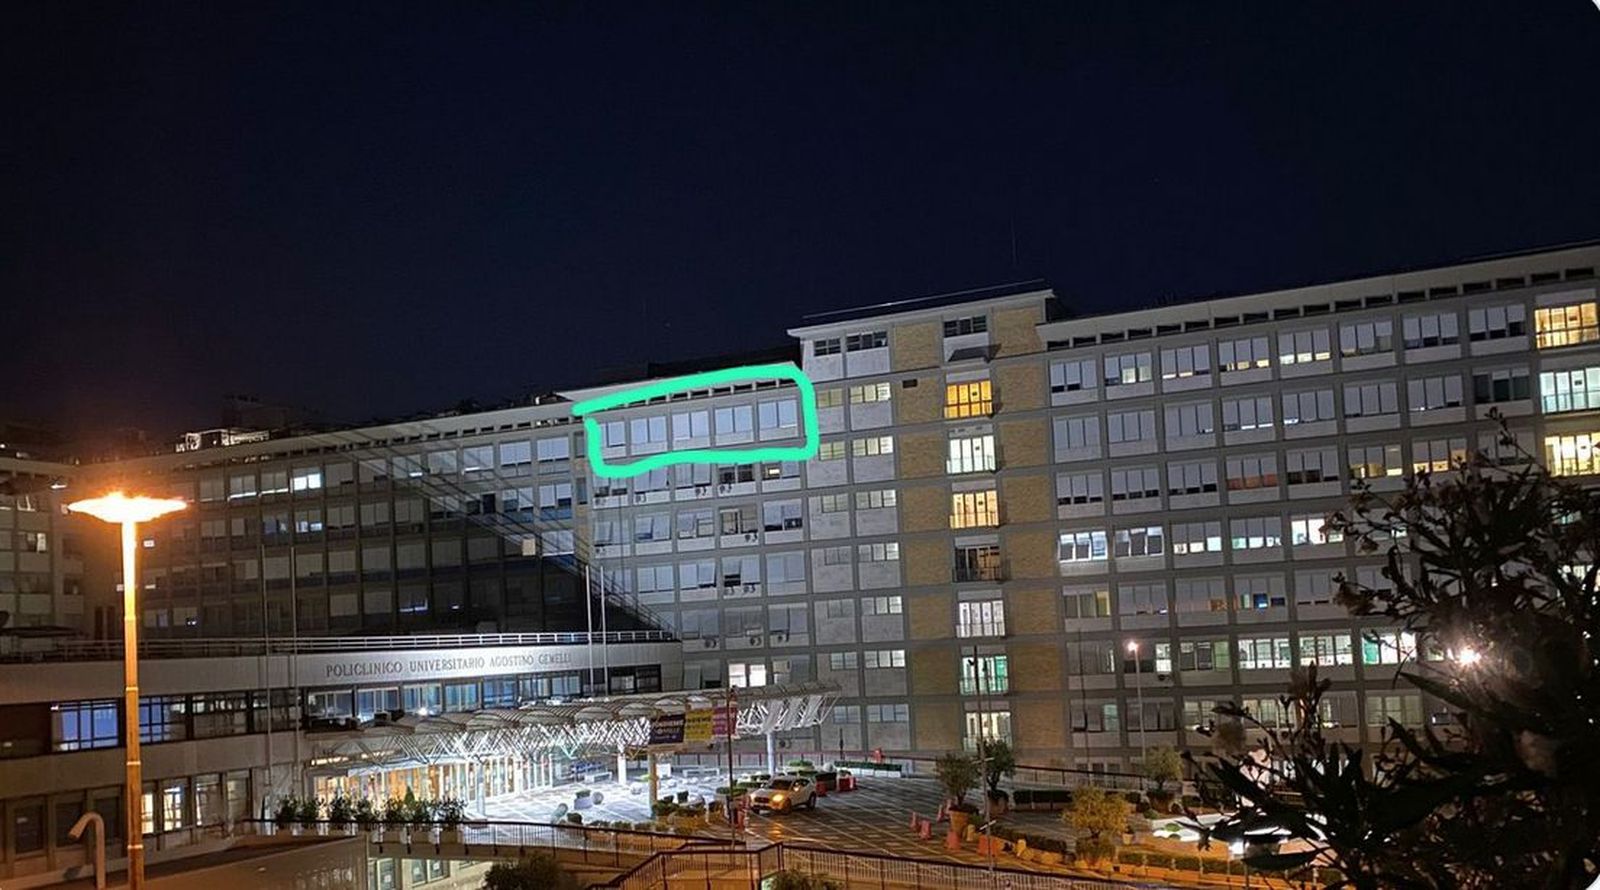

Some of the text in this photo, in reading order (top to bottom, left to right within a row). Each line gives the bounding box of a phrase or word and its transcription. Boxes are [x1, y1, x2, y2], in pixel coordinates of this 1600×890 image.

[326, 661, 403, 677] POLICLINICO
[409, 657, 485, 672] UNIVERSITARIO
[489, 654, 534, 667] AGOSTINO
